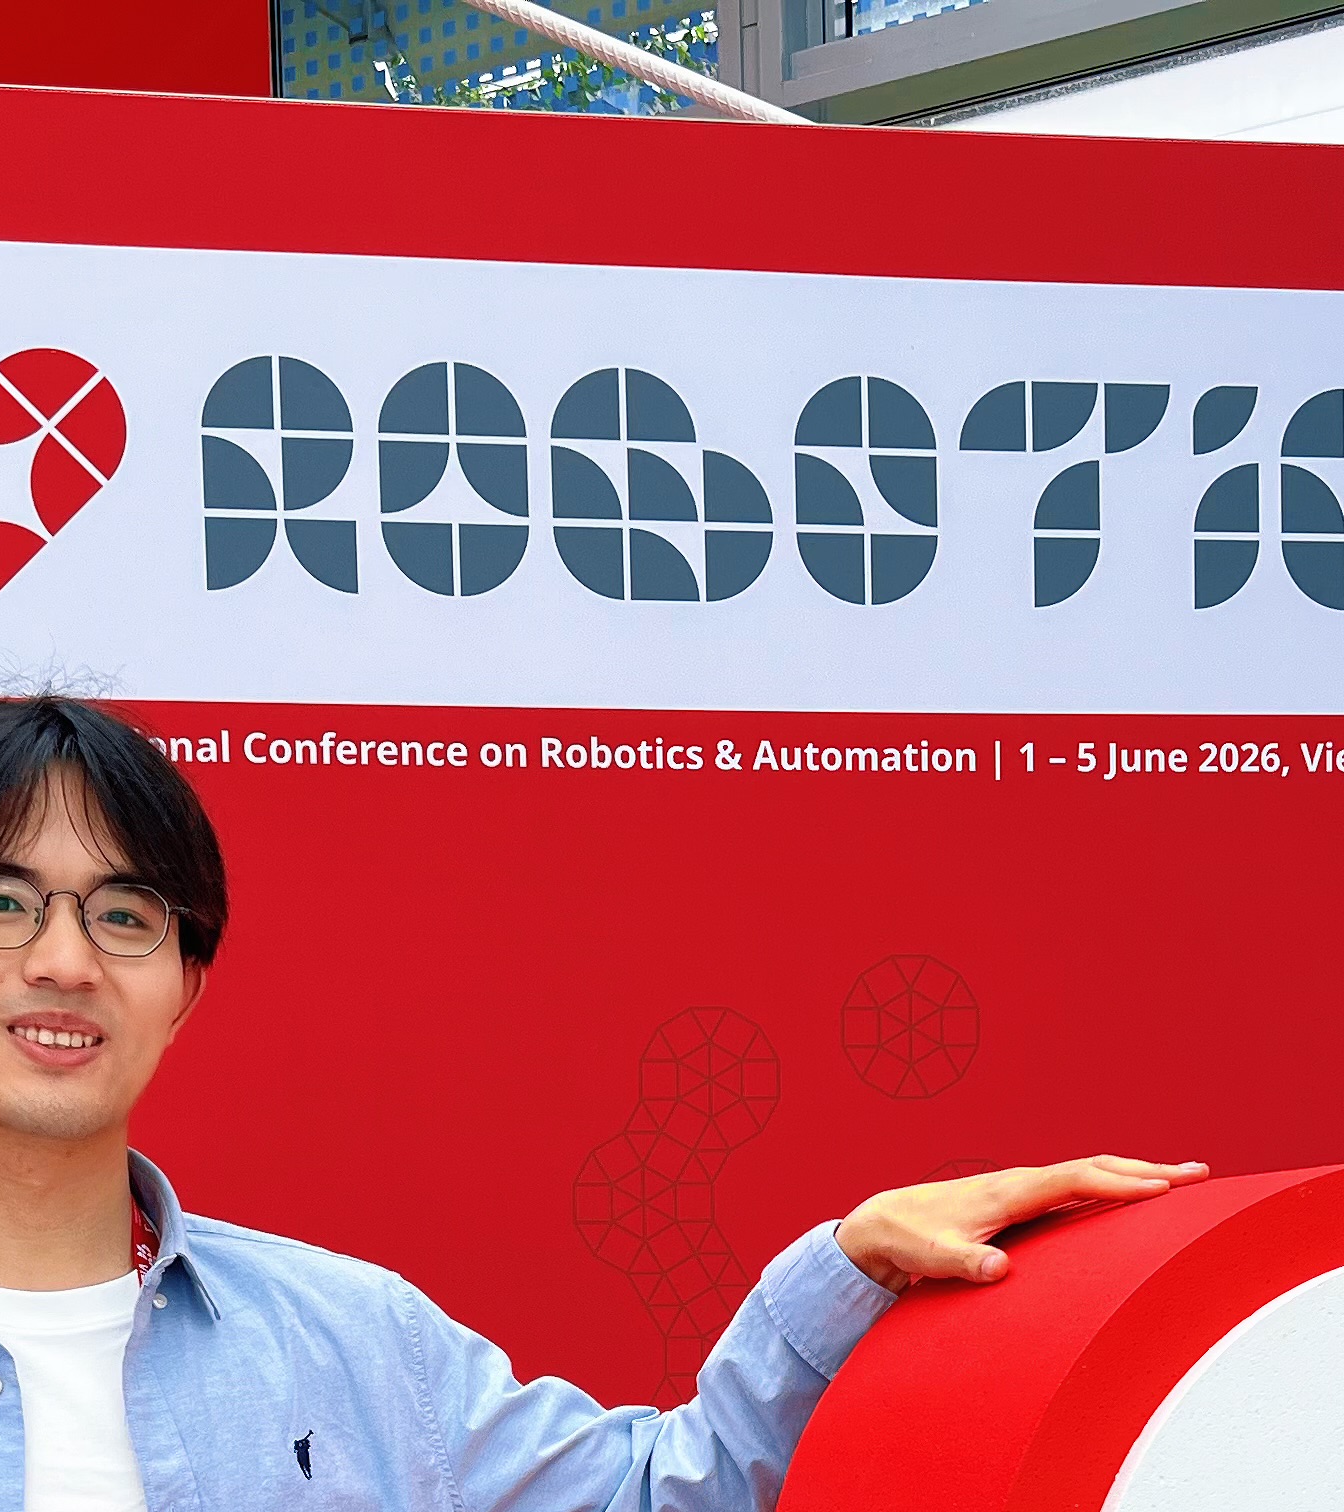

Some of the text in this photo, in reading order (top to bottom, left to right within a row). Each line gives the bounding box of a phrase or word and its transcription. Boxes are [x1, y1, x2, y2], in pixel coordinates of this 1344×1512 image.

[243, 731, 468, 767] Conference
[479, 742, 527, 768] on
[541, 735, 704, 770] Robotics
[714, 739, 743, 771] &
[752, 740, 977, 772] Automation
[1019, 742, 1034, 772] 1
[1077, 742, 1097, 773] 5
[1103, 742, 1188, 781] June
[1198, 742, 1290, 778] 2026,
